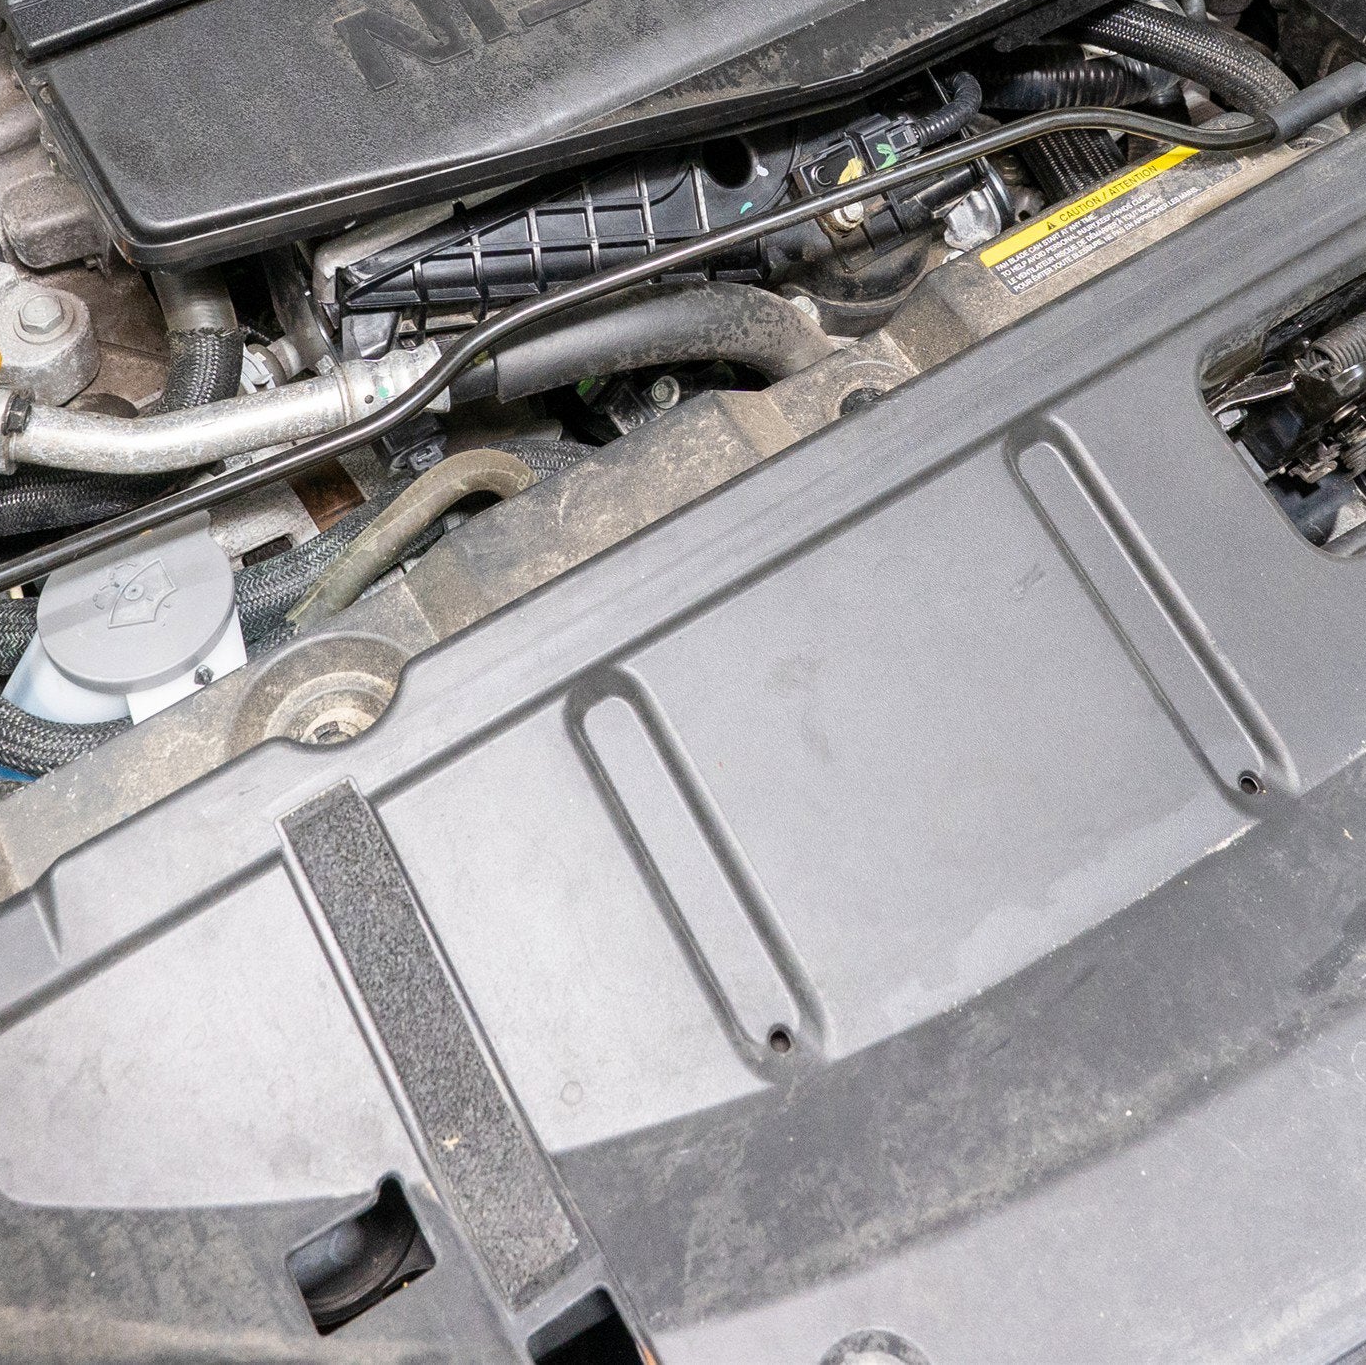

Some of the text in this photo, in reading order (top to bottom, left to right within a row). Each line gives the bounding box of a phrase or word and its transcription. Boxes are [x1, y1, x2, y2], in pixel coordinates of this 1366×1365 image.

[1059, 196, 1101, 221] CAUTION
[1109, 165, 1157, 195] ATTENTION
[995, 261, 1009, 271] FAN
[1007, 250, 1030, 264] BLADE
[1028, 242, 1043, 253] CAN
[1041, 232, 1061, 246] START
[1068, 221, 1081, 231] ANY
[1010, 260, 1027, 272] HELP
[1027, 250, 1046, 264] AVOID
[1045, 234, 1078, 253] PERSONAL
[1110, 201, 1132, 217] HANDS
[1013, 278, 1033, 292] POUR
[1051, 255, 1073, 270] TOUTE
[1133, 202, 1169, 225] APPROCHER
[1015, 256, 1056, 280] VENTILATEUR
[1054, 244, 1078, 259] RISQUE
[1121, 209, 1138, 221] TOUT
